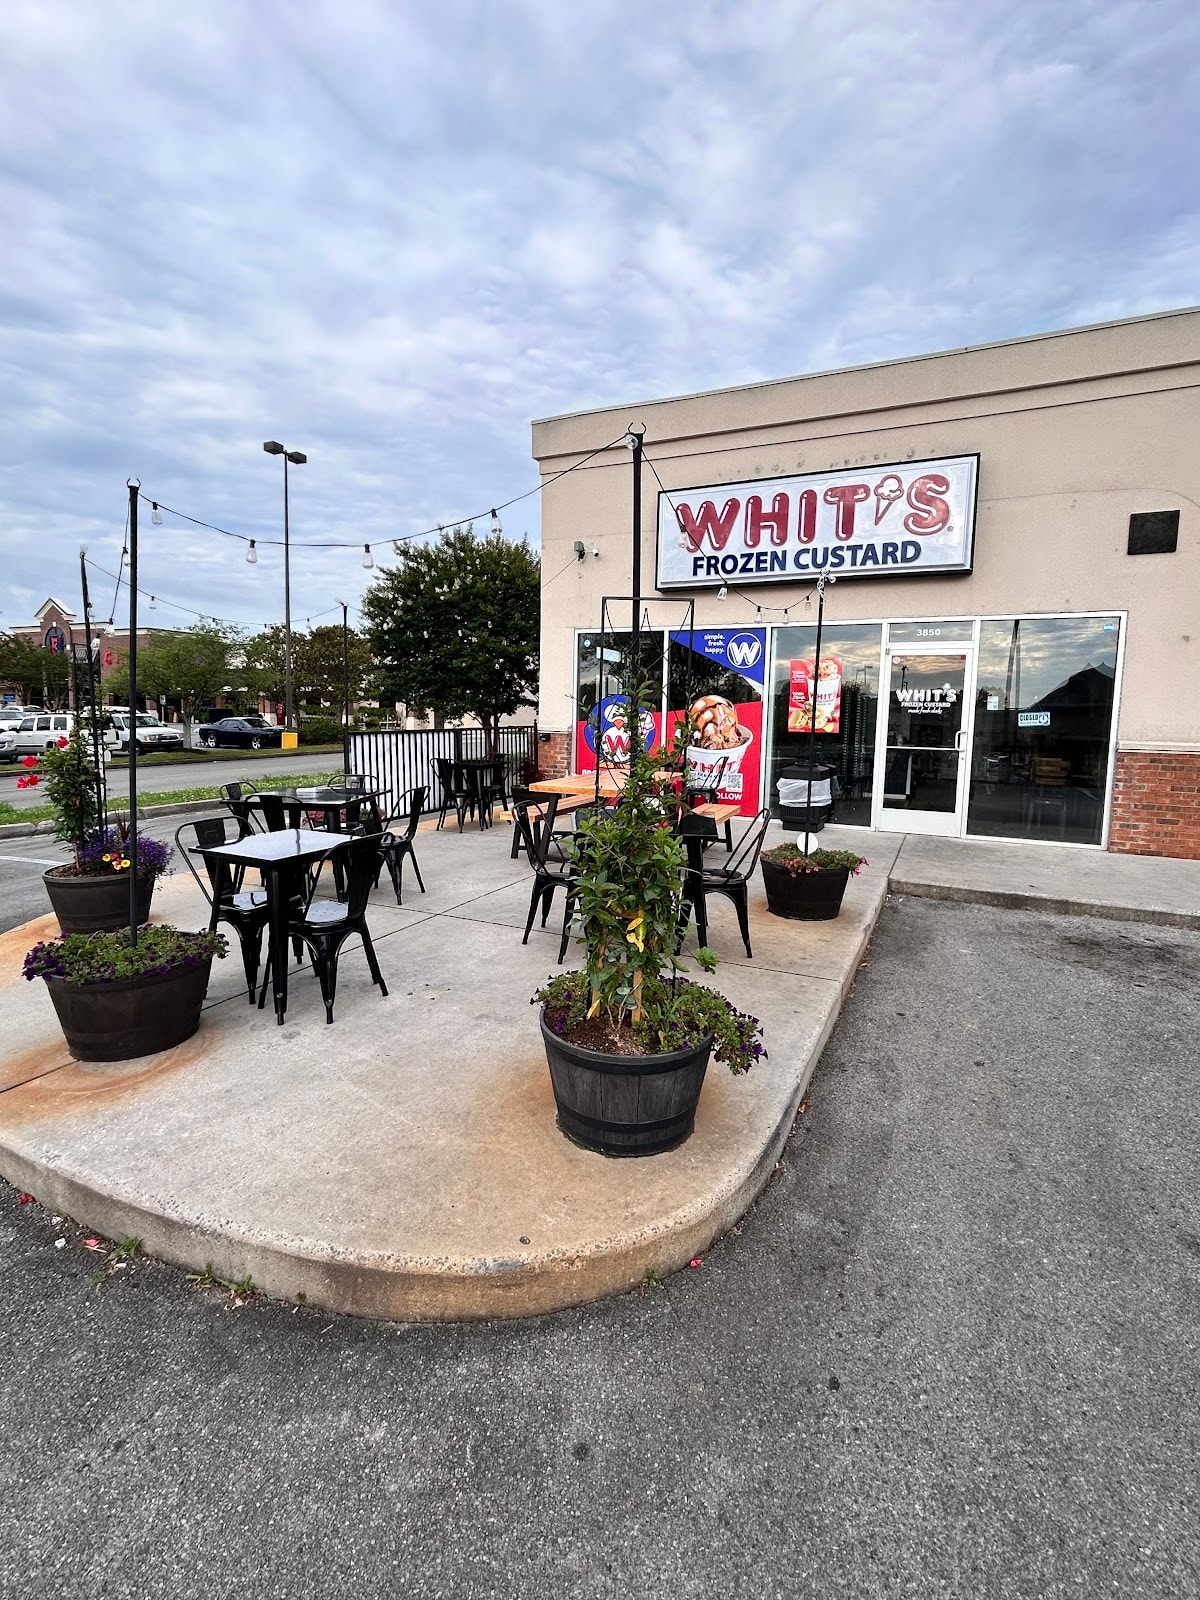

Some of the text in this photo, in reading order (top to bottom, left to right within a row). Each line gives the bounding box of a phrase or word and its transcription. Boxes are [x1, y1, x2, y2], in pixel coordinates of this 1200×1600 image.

[675, 474, 950, 553] WHIT'S
[692, 540, 922, 577] FROZEN CUSTARD
[916, 628, 941, 636] 3850
[896, 683, 957, 702] WHIT'S
[716, 792, 743, 800] OLLOW
